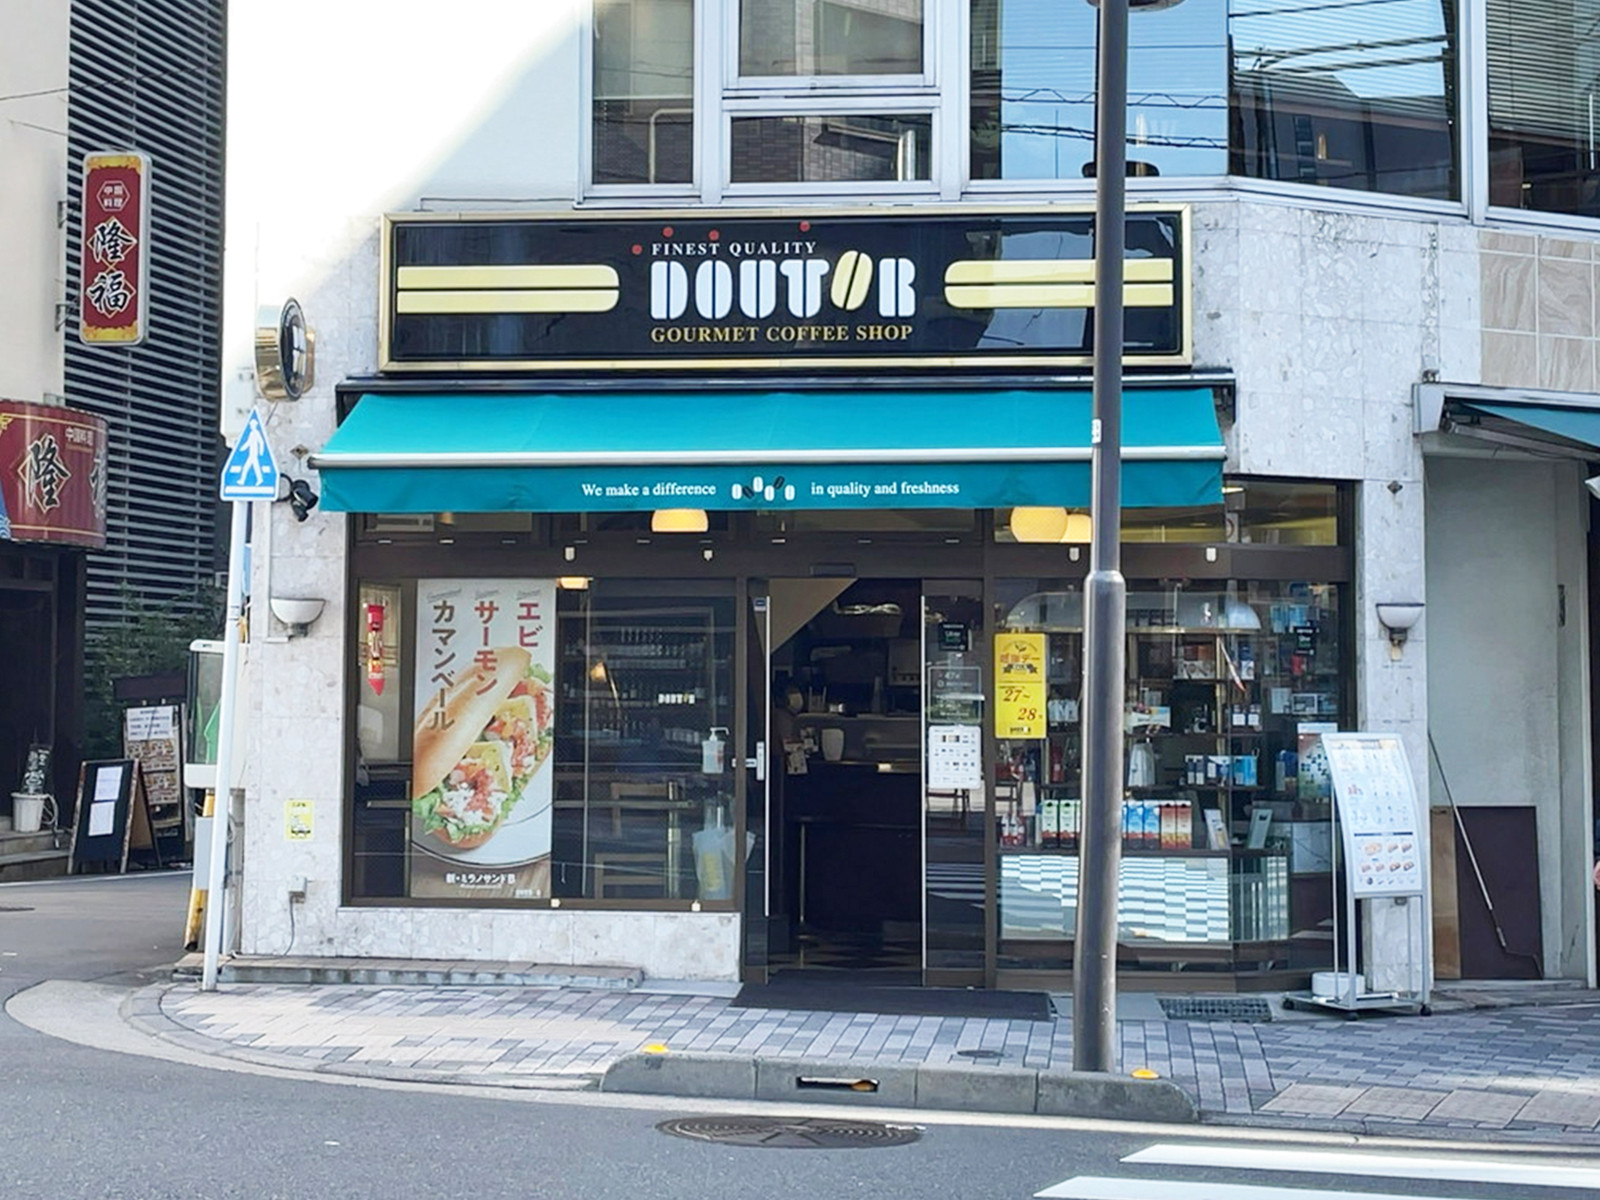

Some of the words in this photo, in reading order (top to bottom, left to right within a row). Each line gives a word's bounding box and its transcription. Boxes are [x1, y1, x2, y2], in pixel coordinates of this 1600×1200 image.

[651, 242, 721, 256] FINEST
[729, 241, 817, 257] QUALITY
[650, 250, 916, 320] DOUTOR
[651, 326, 759, 343] GOURMET
[766, 325, 849, 342] COFFEE
[855, 324, 913, 341] SHOP
[581, 483, 602, 496] We
[605, 483, 638, 496] make
[642, 485, 650, 496] a
[652, 482, 717, 496] difference
[811, 482, 824, 495] in
[826, 482, 871, 498] quality
[874, 481, 897, 495] and
[901, 481, 960, 495] freshness
[473, 600, 499, 696] サーモン
[516, 601, 543, 648] エビ
[431, 600, 456, 731] カマンベール
